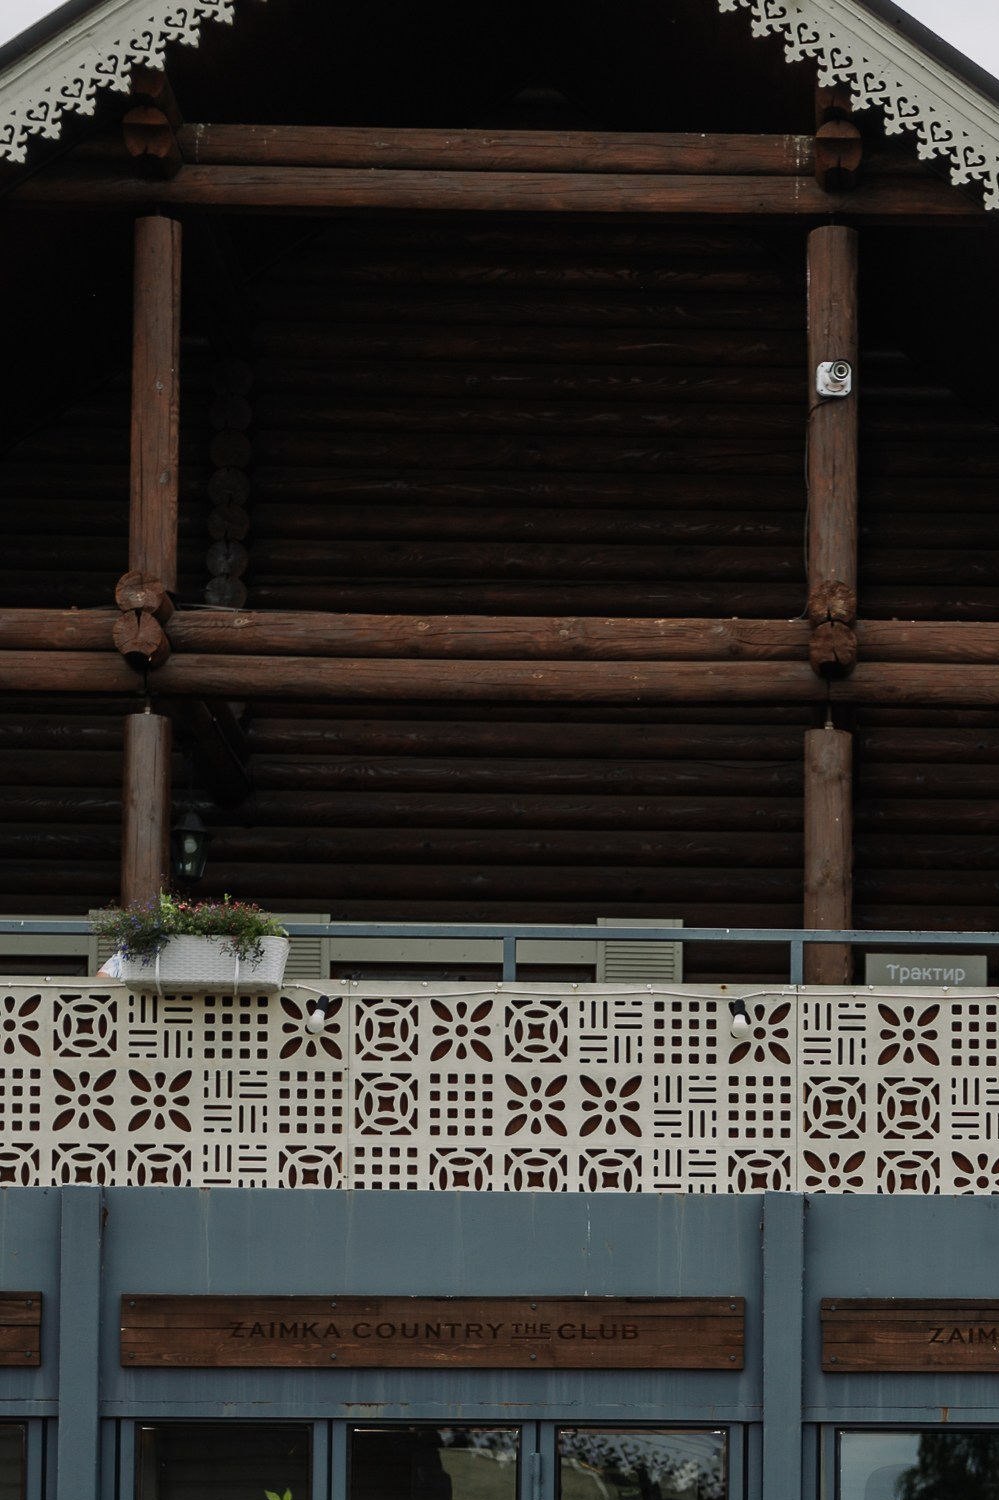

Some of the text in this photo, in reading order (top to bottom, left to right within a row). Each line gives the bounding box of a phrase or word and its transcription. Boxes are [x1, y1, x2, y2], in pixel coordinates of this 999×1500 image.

[886, 964, 966, 984] Трактир
[229, 1321, 640, 1340] ZAIMKA COUNTRY THE CLUB
